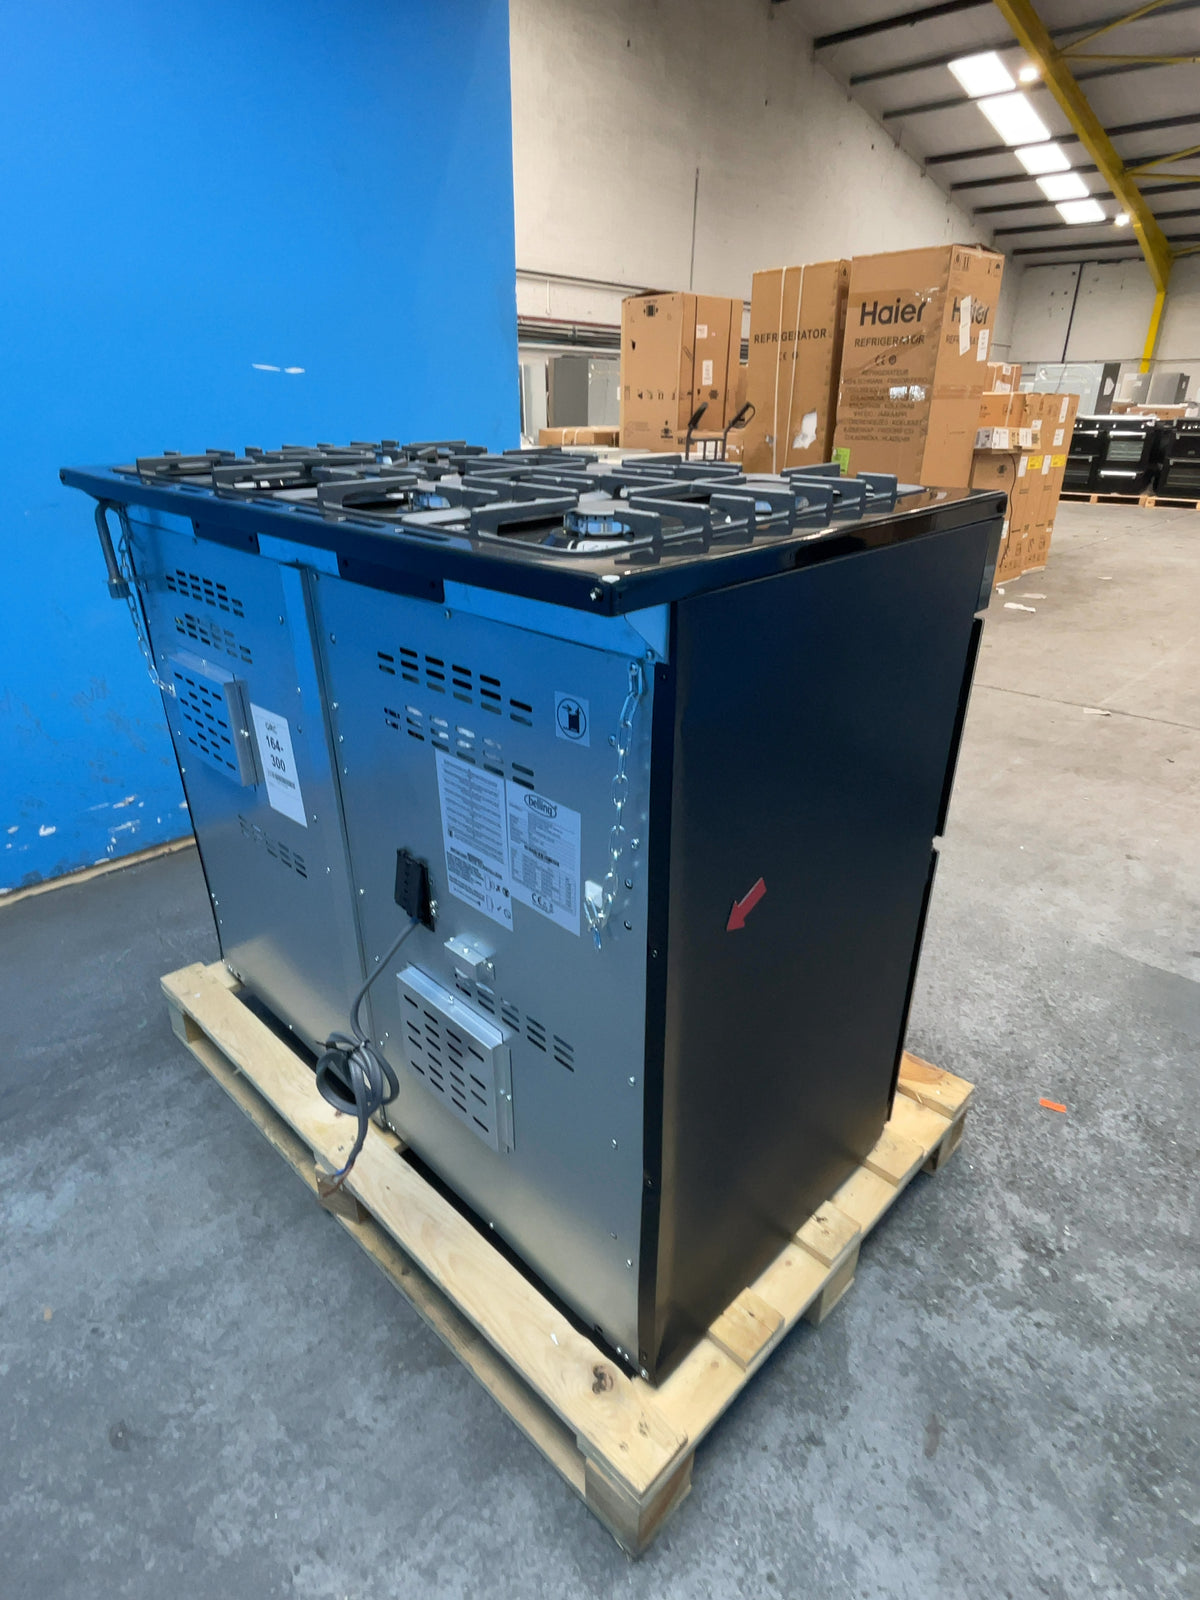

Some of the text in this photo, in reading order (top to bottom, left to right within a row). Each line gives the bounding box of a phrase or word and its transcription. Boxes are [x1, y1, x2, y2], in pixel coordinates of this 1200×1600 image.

[860, 297, 927, 327] Haier
[951, 296, 990, 325] Hier
[753, 328, 827, 344] REFRGERATOR
[270, 754, 286, 773] 300
[528, 794, 554, 818] belling
